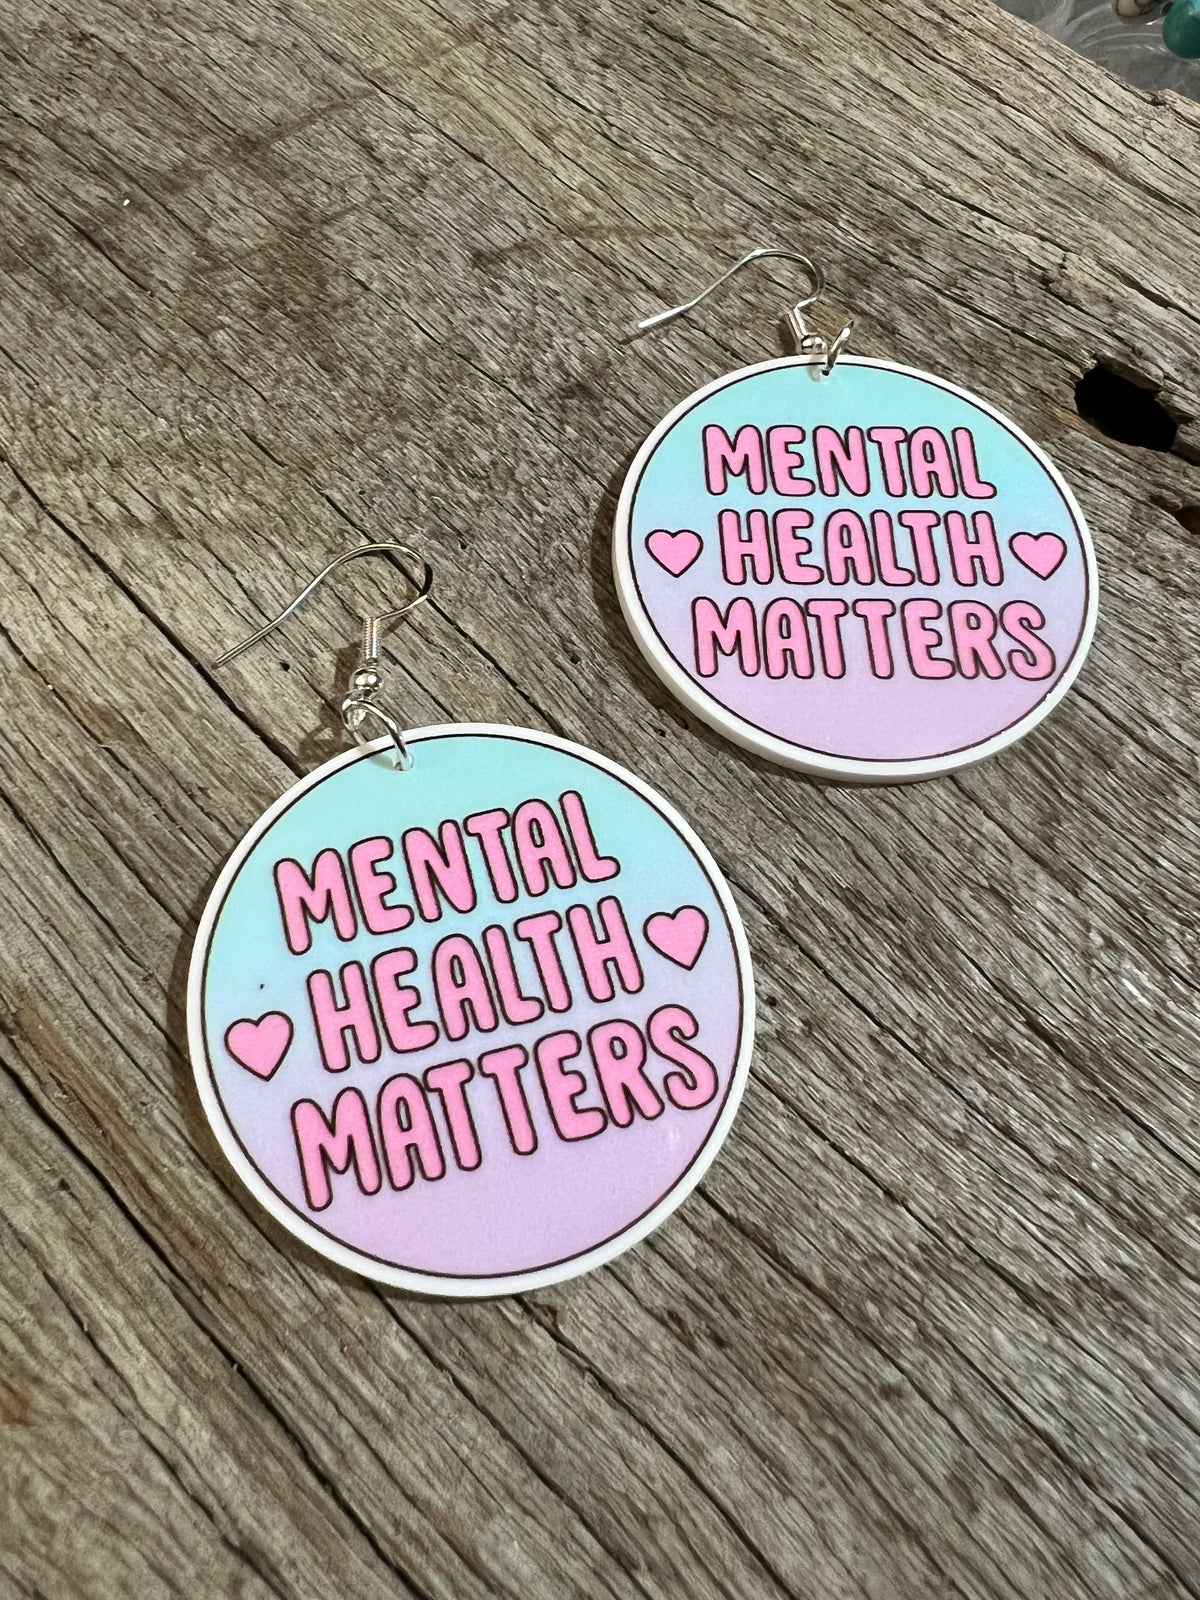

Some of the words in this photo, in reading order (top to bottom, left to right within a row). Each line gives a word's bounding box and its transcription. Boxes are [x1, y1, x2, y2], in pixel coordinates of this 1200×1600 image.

[702, 425, 997, 498] MENTAL
[718, 509, 1004, 587] HEALTH
[691, 596, 1057, 682] MATTERS
[273, 790, 620, 956] MENTAL
[306, 895, 643, 1073] HEALTH
[290, 1004, 719, 1212] MATTERS
